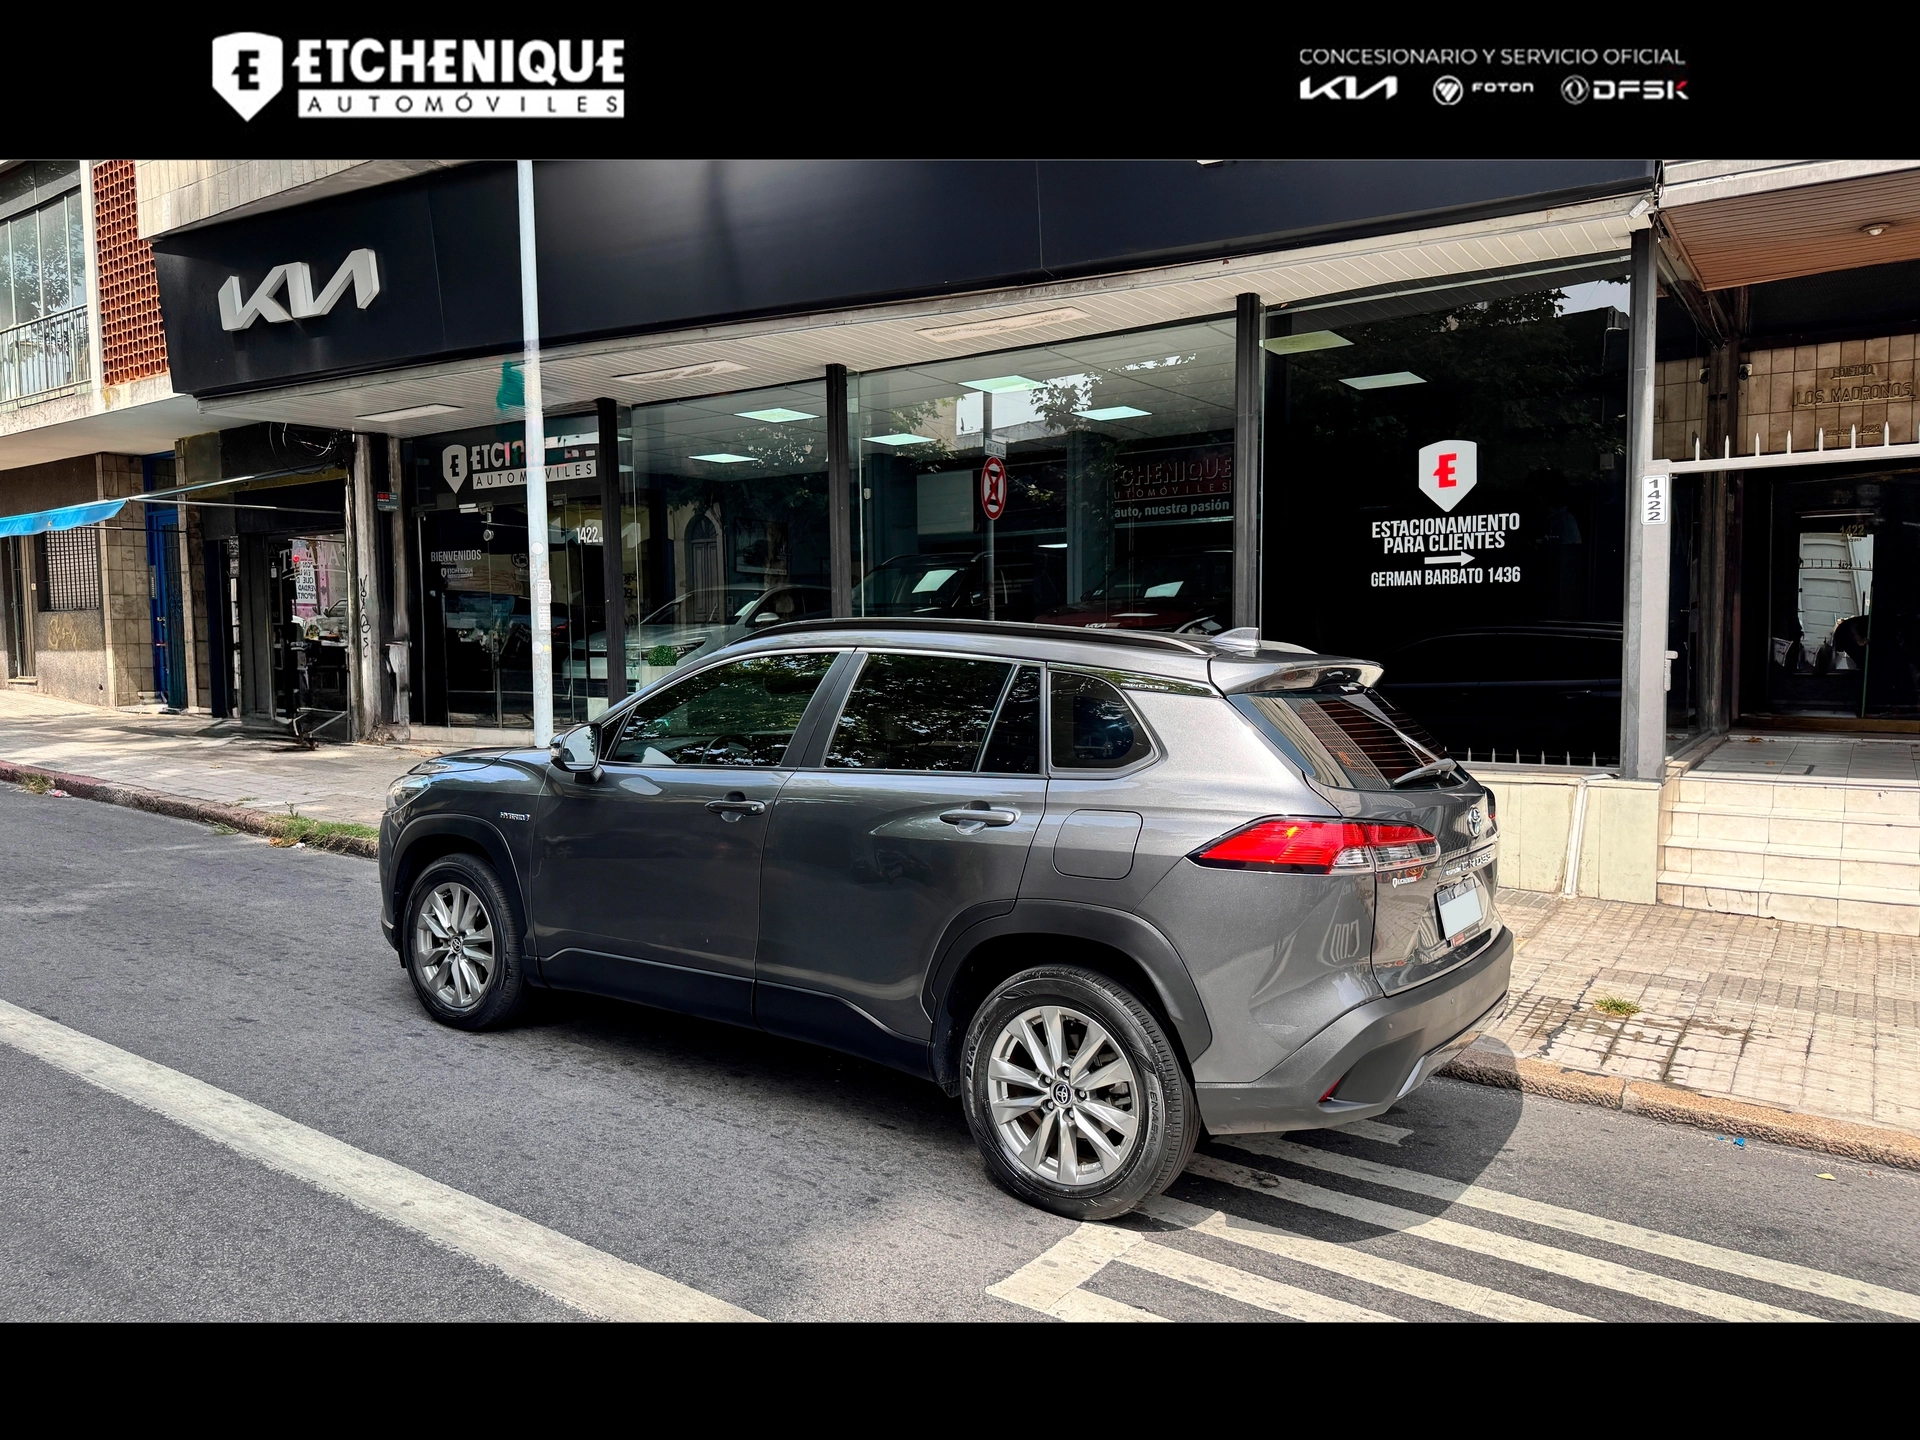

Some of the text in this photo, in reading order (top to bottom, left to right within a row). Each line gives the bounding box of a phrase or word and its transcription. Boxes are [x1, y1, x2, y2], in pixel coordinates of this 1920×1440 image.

[218, 247, 380, 331] KIA
[1795, 379, 1914, 406] LOS MADROÑOS
[475, 463, 592, 487] AUTOMVILES
[1121, 457, 1231, 486] CHENIQUE
[1114, 482, 1228, 499] UTOMÓVILES
[1646, 479, 1662, 521] 1422
[1114, 499, 1230, 518] auto, nuestra pasión
[576, 526, 599, 544] 1422
[1372, 512, 1520, 538] ESTACIONAMIENTO
[1384, 531, 1506, 554] PARA CLIENTES
[430, 549, 482, 562] BIENVENIDOS
[1371, 566, 1521, 587] GERMAN BARBATO 1436
